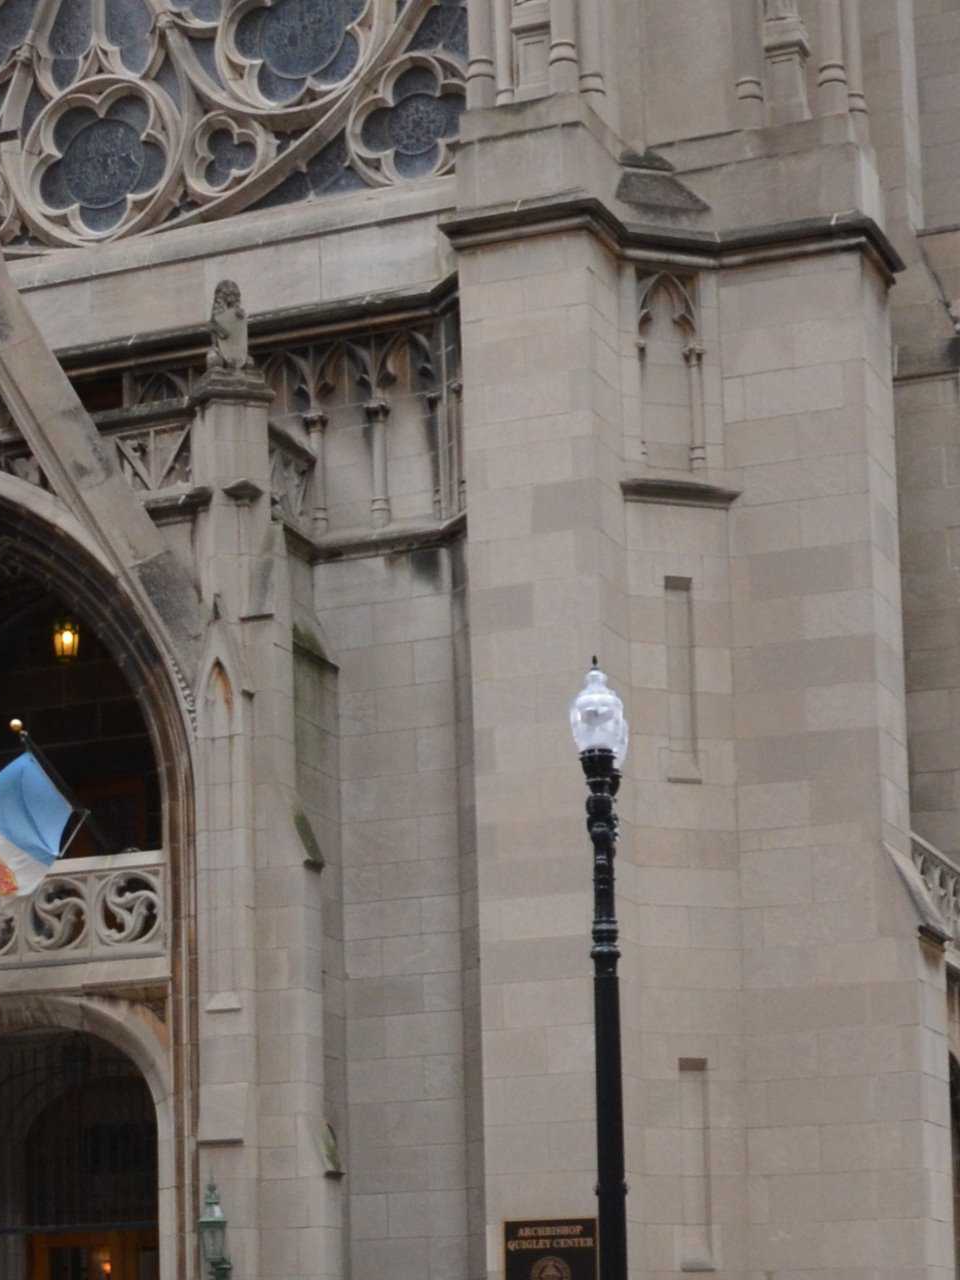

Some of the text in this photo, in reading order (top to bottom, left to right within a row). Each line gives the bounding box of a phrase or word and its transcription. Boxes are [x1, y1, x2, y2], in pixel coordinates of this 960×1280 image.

[517, 1225, 583, 1237] ARCHBISHOP
[507, 1237, 593, 1251] QUIGLEY CENTER
